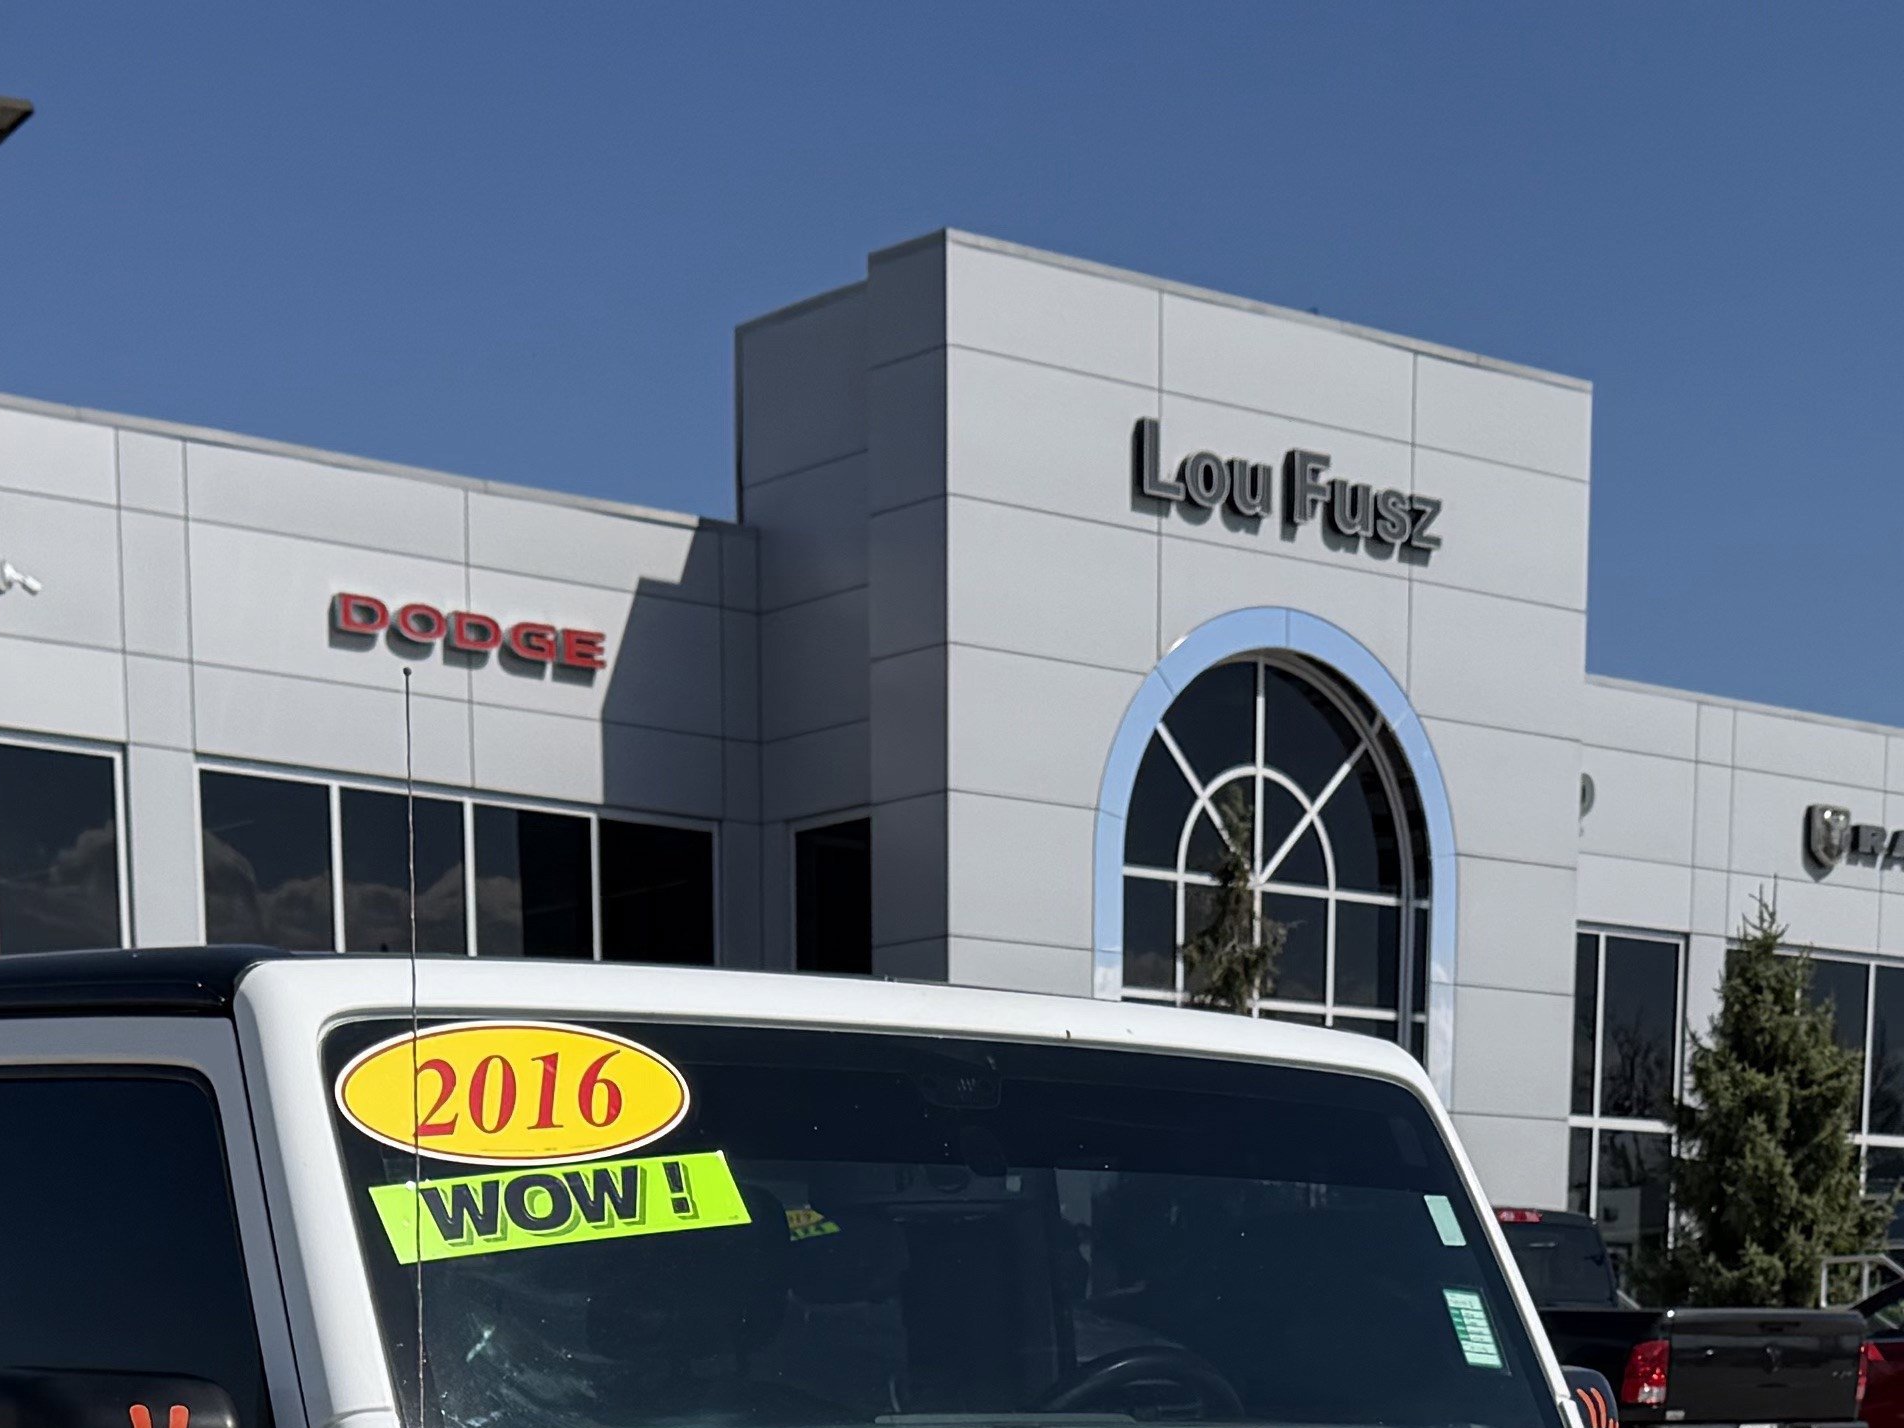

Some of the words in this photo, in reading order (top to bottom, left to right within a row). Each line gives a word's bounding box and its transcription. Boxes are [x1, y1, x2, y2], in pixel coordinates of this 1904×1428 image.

[1131, 416, 1273, 518] Lou
[1281, 447, 1443, 552] Fusz
[332, 591, 607, 670] DODGE
[412, 1049, 623, 1138] 2016
